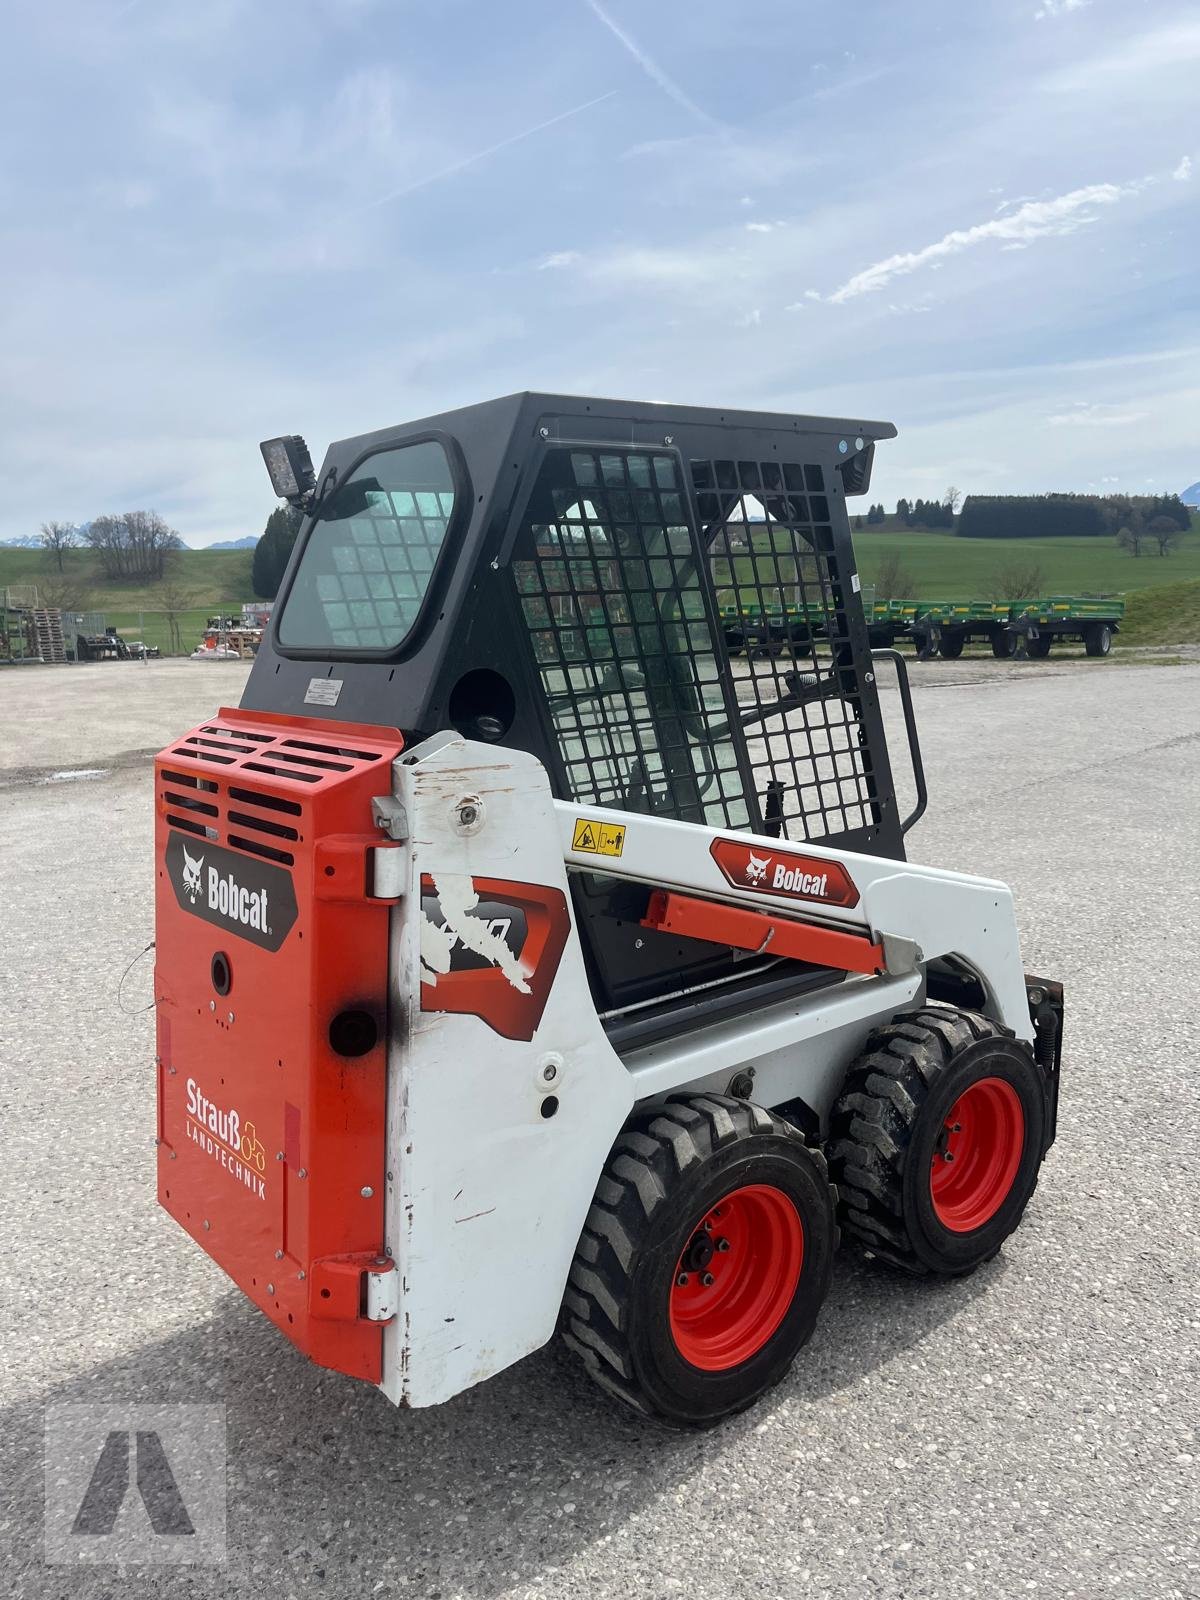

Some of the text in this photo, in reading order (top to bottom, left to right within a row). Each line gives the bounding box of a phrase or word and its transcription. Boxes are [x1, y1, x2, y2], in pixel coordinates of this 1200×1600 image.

[772, 863, 828, 897] Bobcat
[186, 1077, 241, 1151] Strauß
[186, 1120, 265, 1200] LANDTECHNIK
